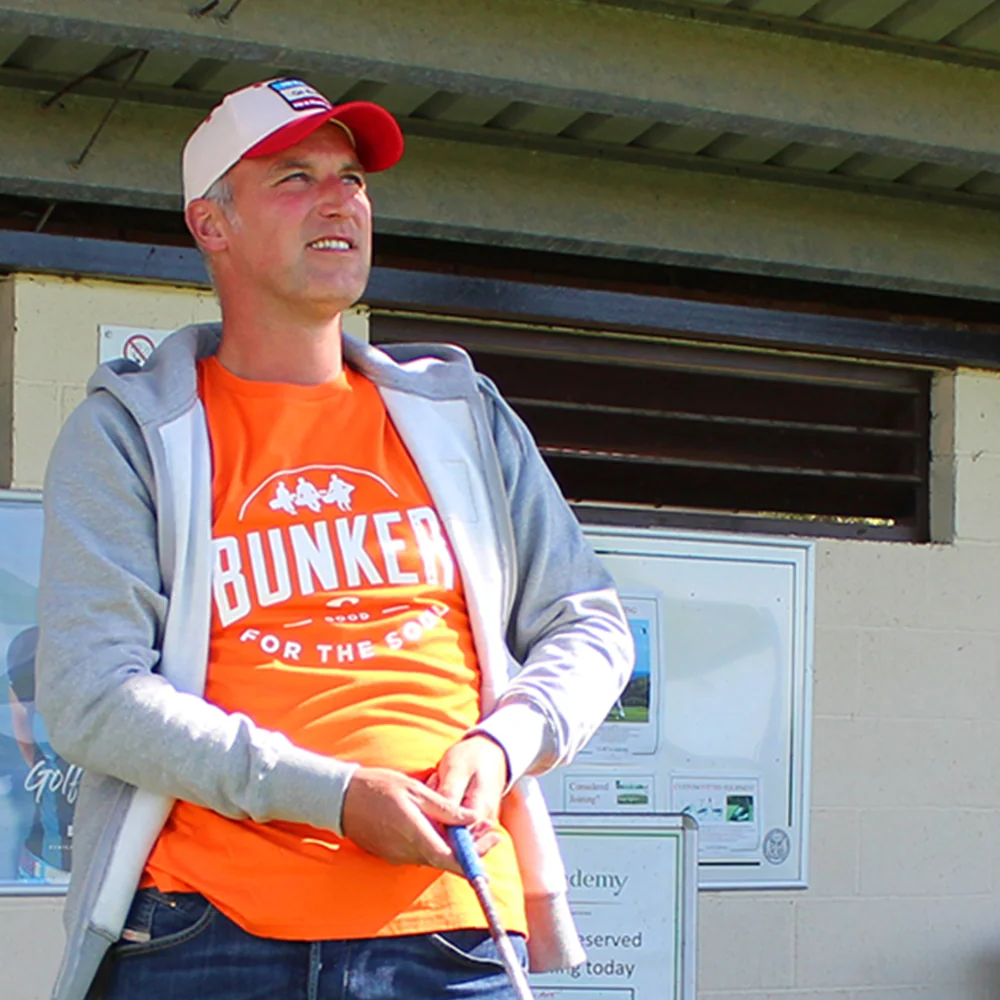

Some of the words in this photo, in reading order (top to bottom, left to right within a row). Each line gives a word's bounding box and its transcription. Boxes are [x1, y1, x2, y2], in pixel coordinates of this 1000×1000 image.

[211, 506, 454, 628] BUNKER
[239, 627, 304, 661] FOR
[316, 640, 377, 663] THE
[385, 604, 451, 651] SOUL
[23, 760, 83, 804] Golf
[566, 869, 629, 897] demy
[578, 932, 643, 948] eserved
[586, 960, 636, 980] today
